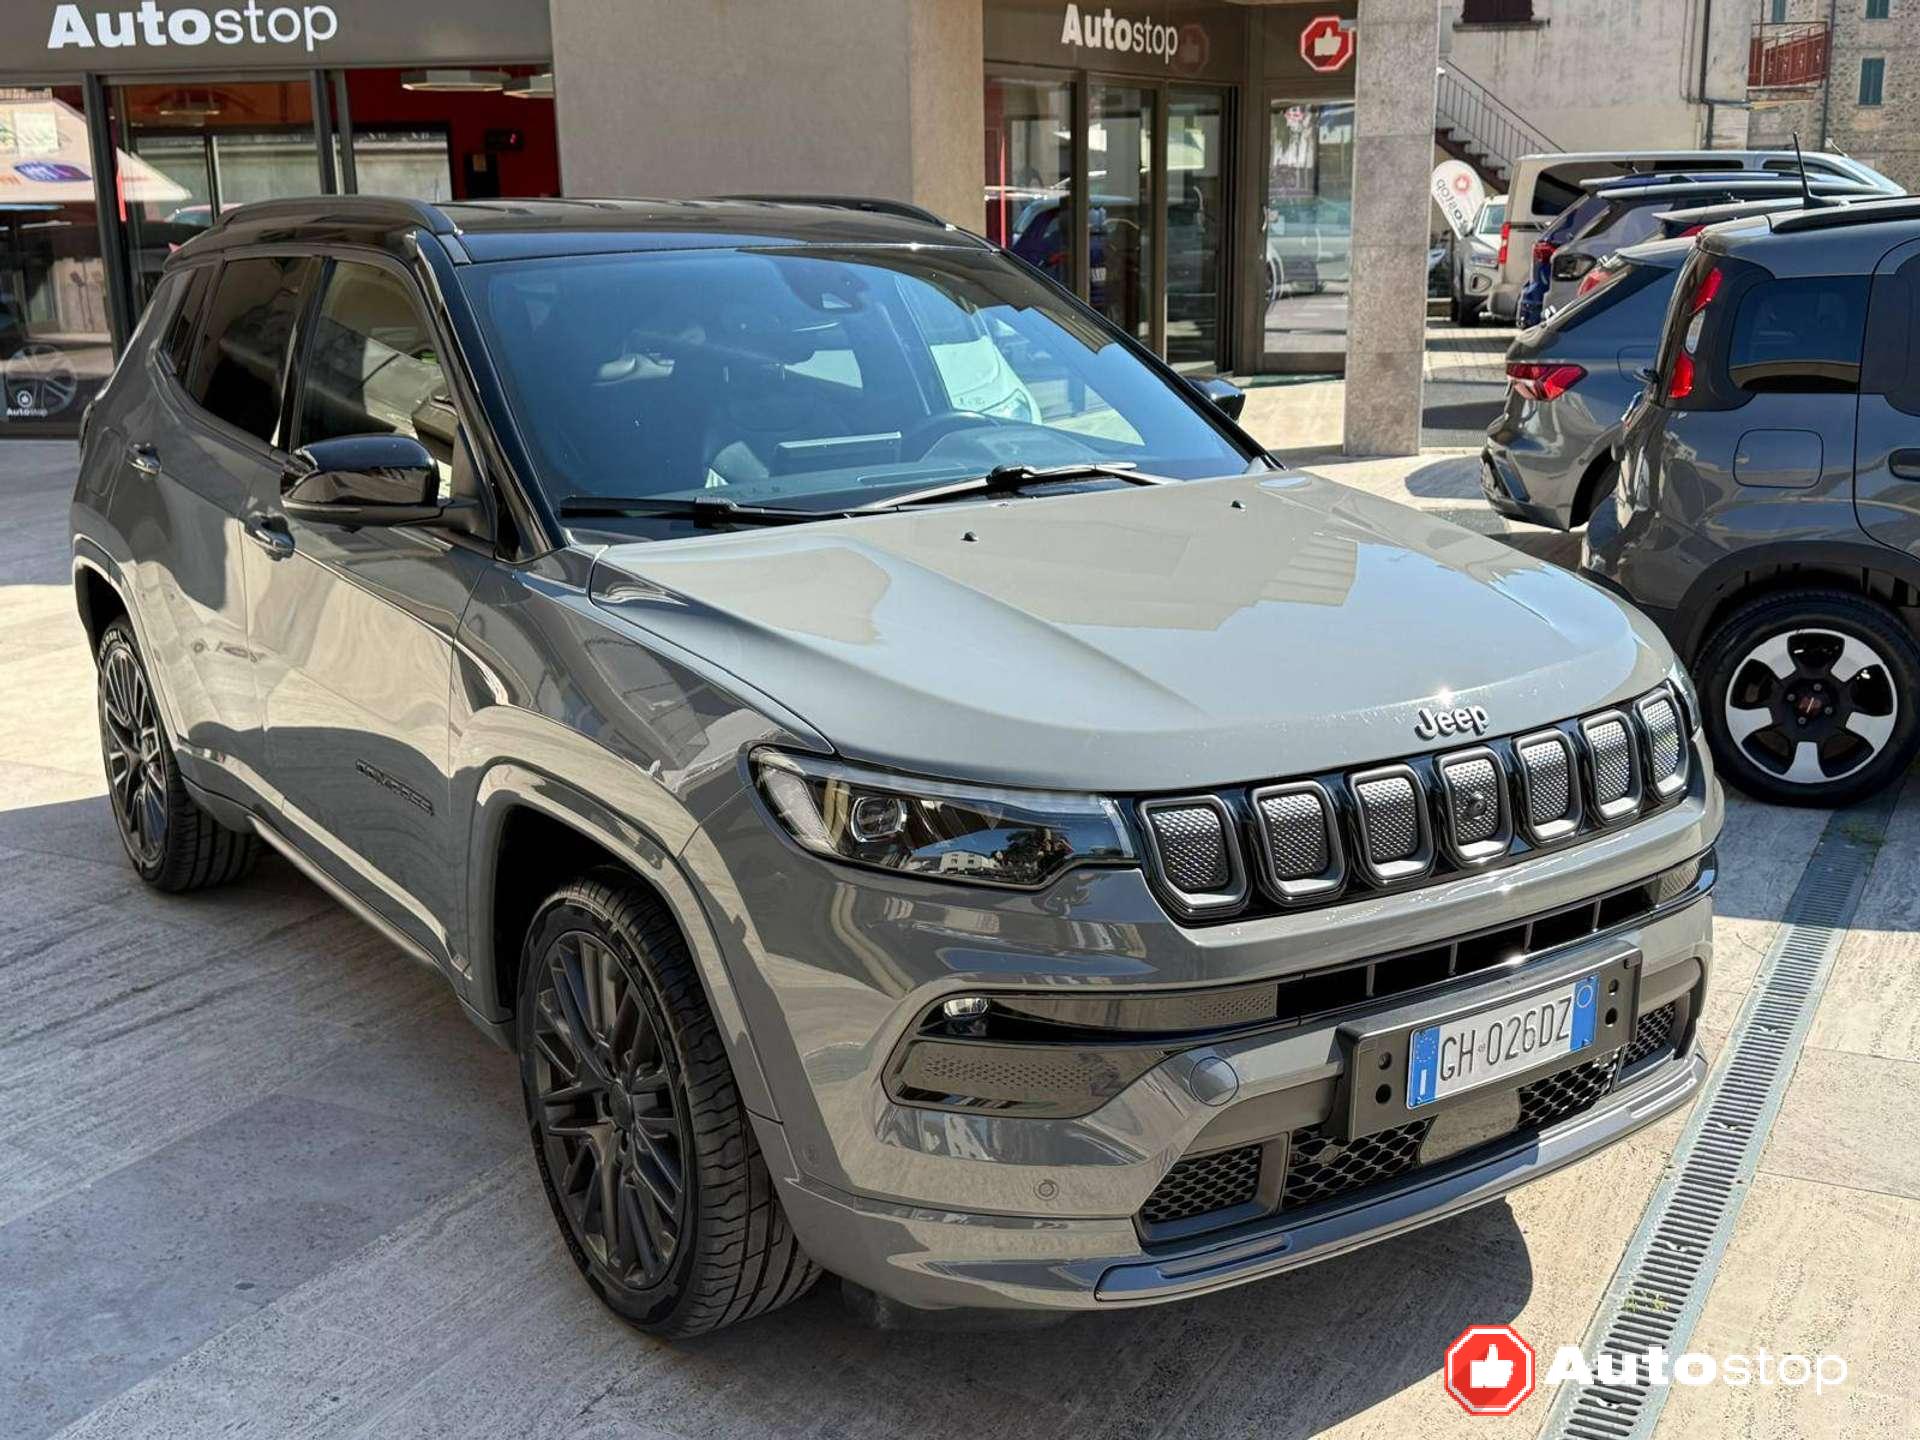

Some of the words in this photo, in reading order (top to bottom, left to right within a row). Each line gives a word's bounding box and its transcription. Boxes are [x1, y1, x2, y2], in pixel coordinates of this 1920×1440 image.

[47, 0, 338, 52] Autostop
[1061, 3, 1178, 65] Autostop
[1414, 705, 1489, 741] Jeep
